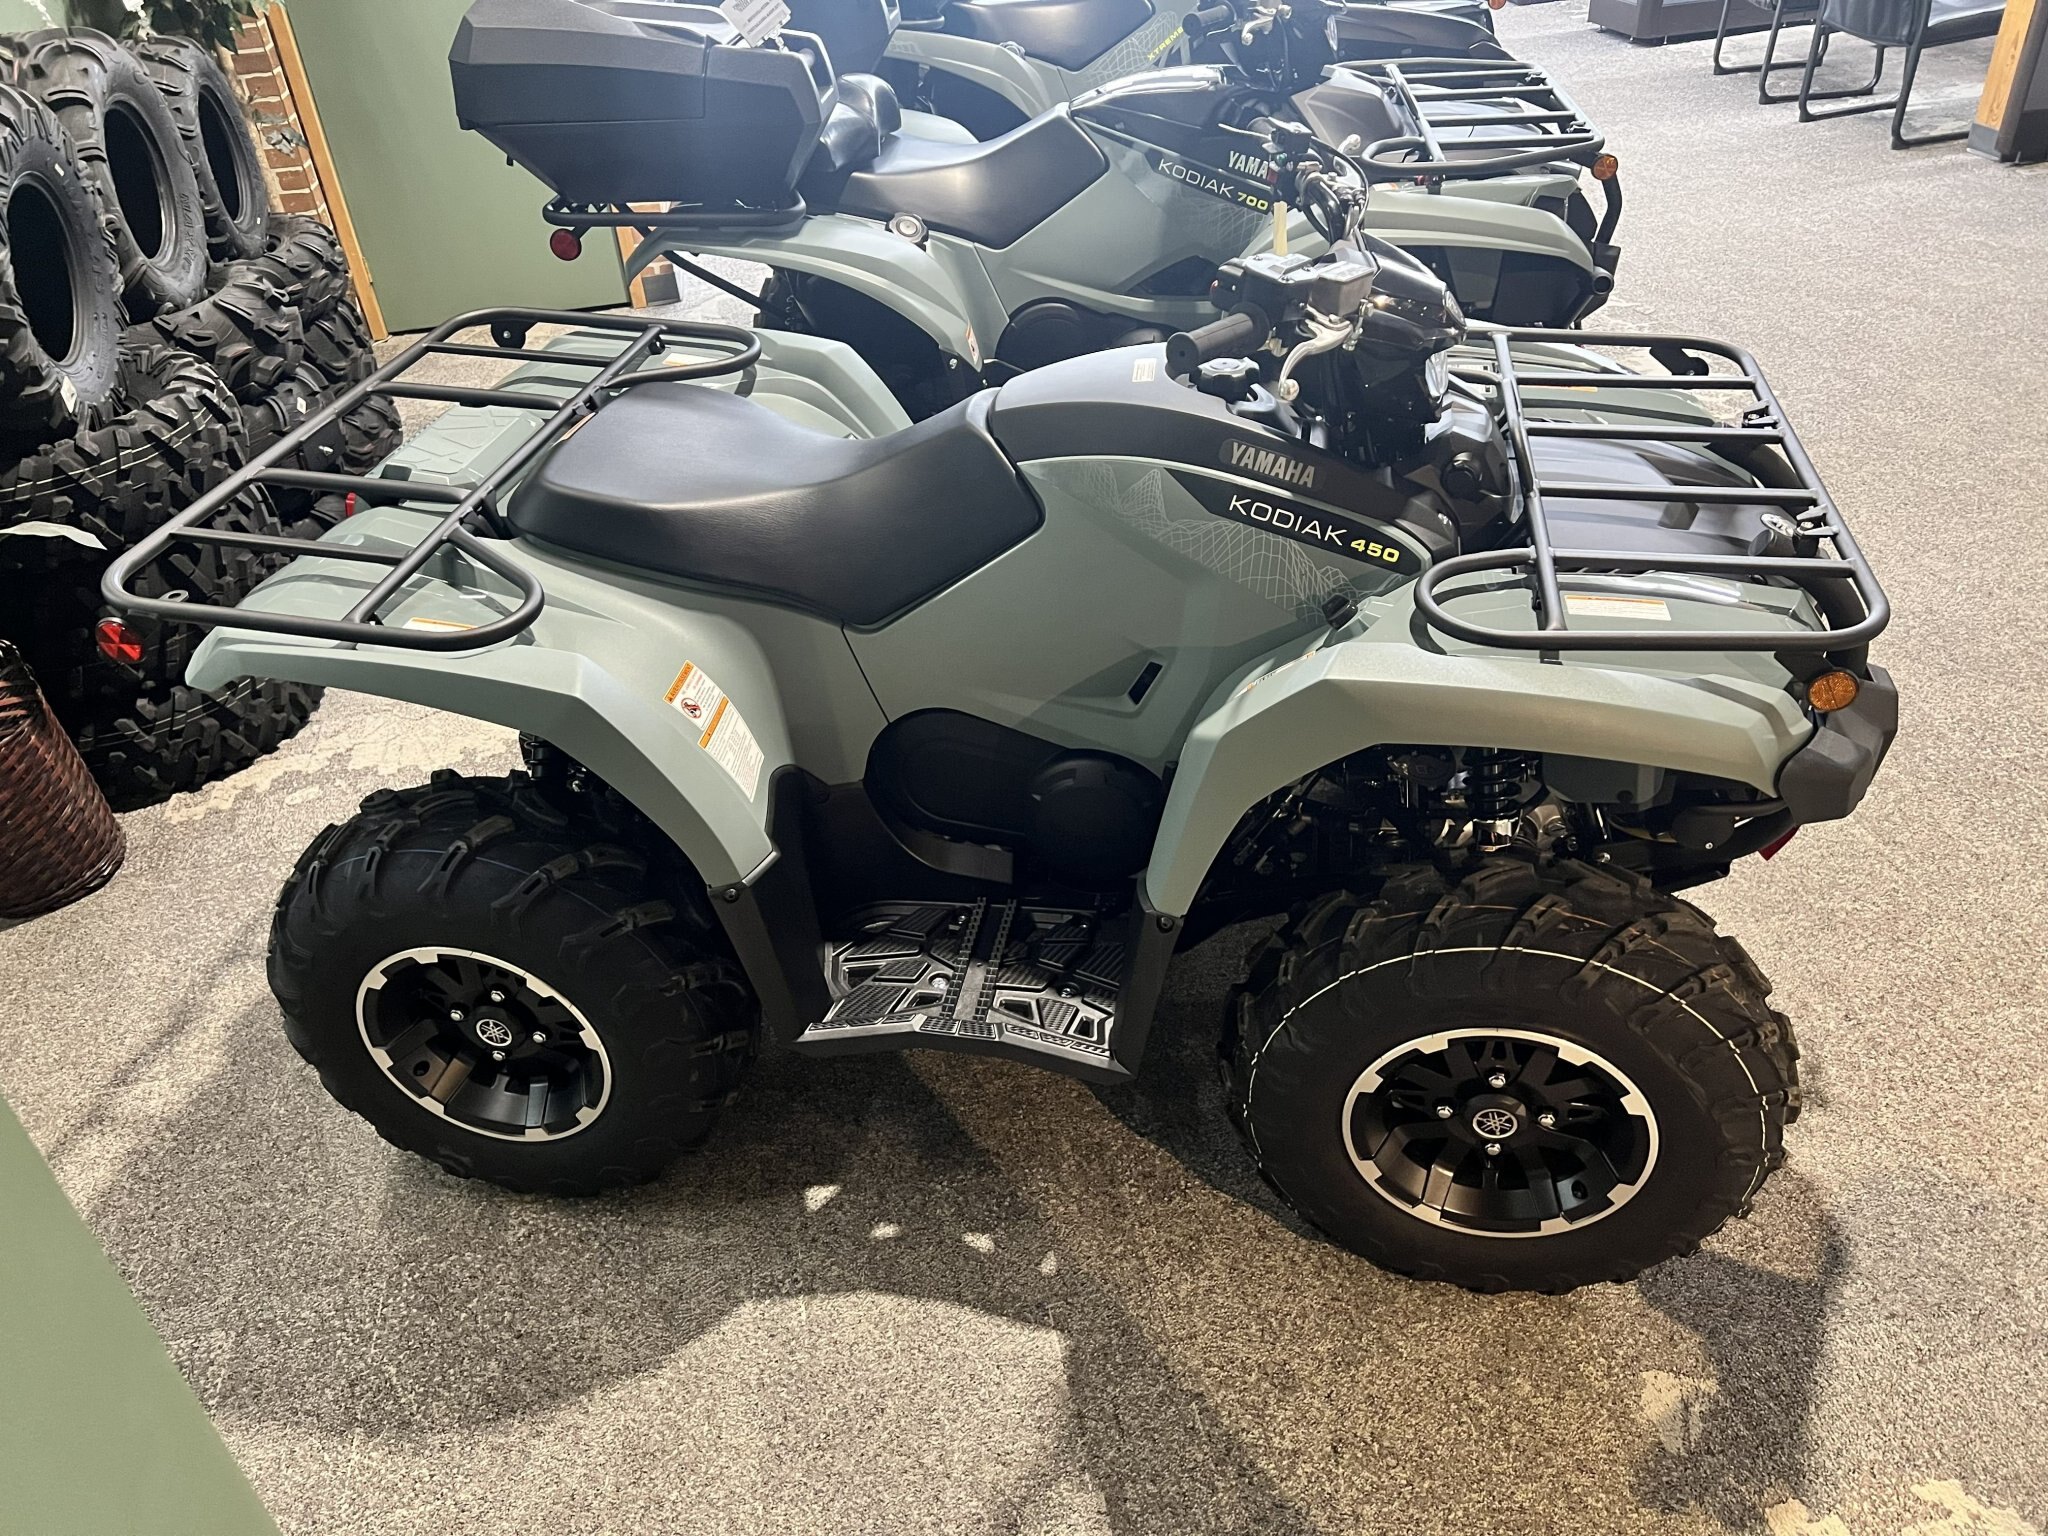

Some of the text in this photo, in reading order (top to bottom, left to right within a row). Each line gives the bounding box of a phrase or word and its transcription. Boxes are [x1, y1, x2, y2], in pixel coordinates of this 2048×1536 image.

[1158, 158, 1269, 211] KODIAK 700
[1228, 150, 1269, 180] YAMA
[1230, 441, 1315, 488] YAMAHA
[1228, 494, 1400, 563] KODIAK 450
